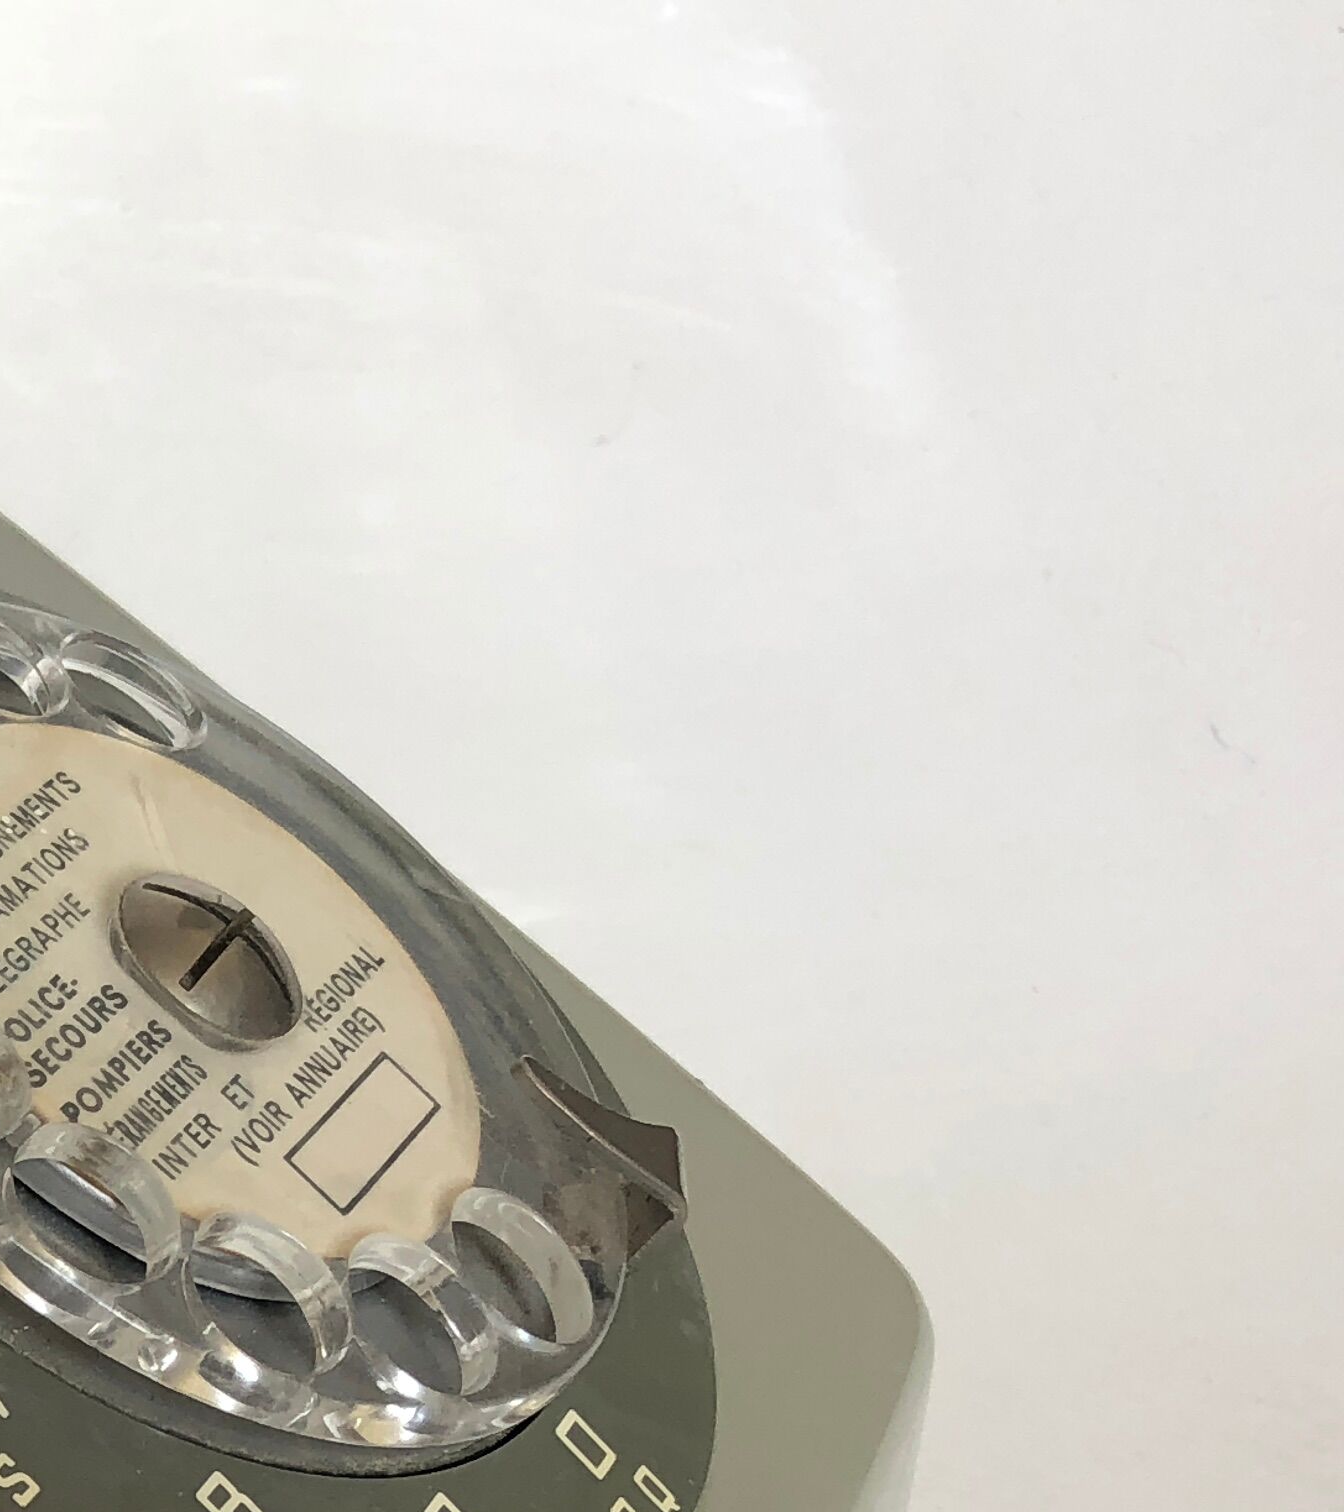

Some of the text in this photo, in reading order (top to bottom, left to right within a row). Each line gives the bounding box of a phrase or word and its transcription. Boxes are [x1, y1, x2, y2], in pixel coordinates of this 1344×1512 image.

[25, 984, 129, 1088] SECOURS
[59, 1019, 172, 1123] POMPIERS
[230, 1006, 386, 1168] (VOIR ANNUAIRE)
[152, 1112, 223, 1181] INTER
[220, 1074, 256, 1111] ET
